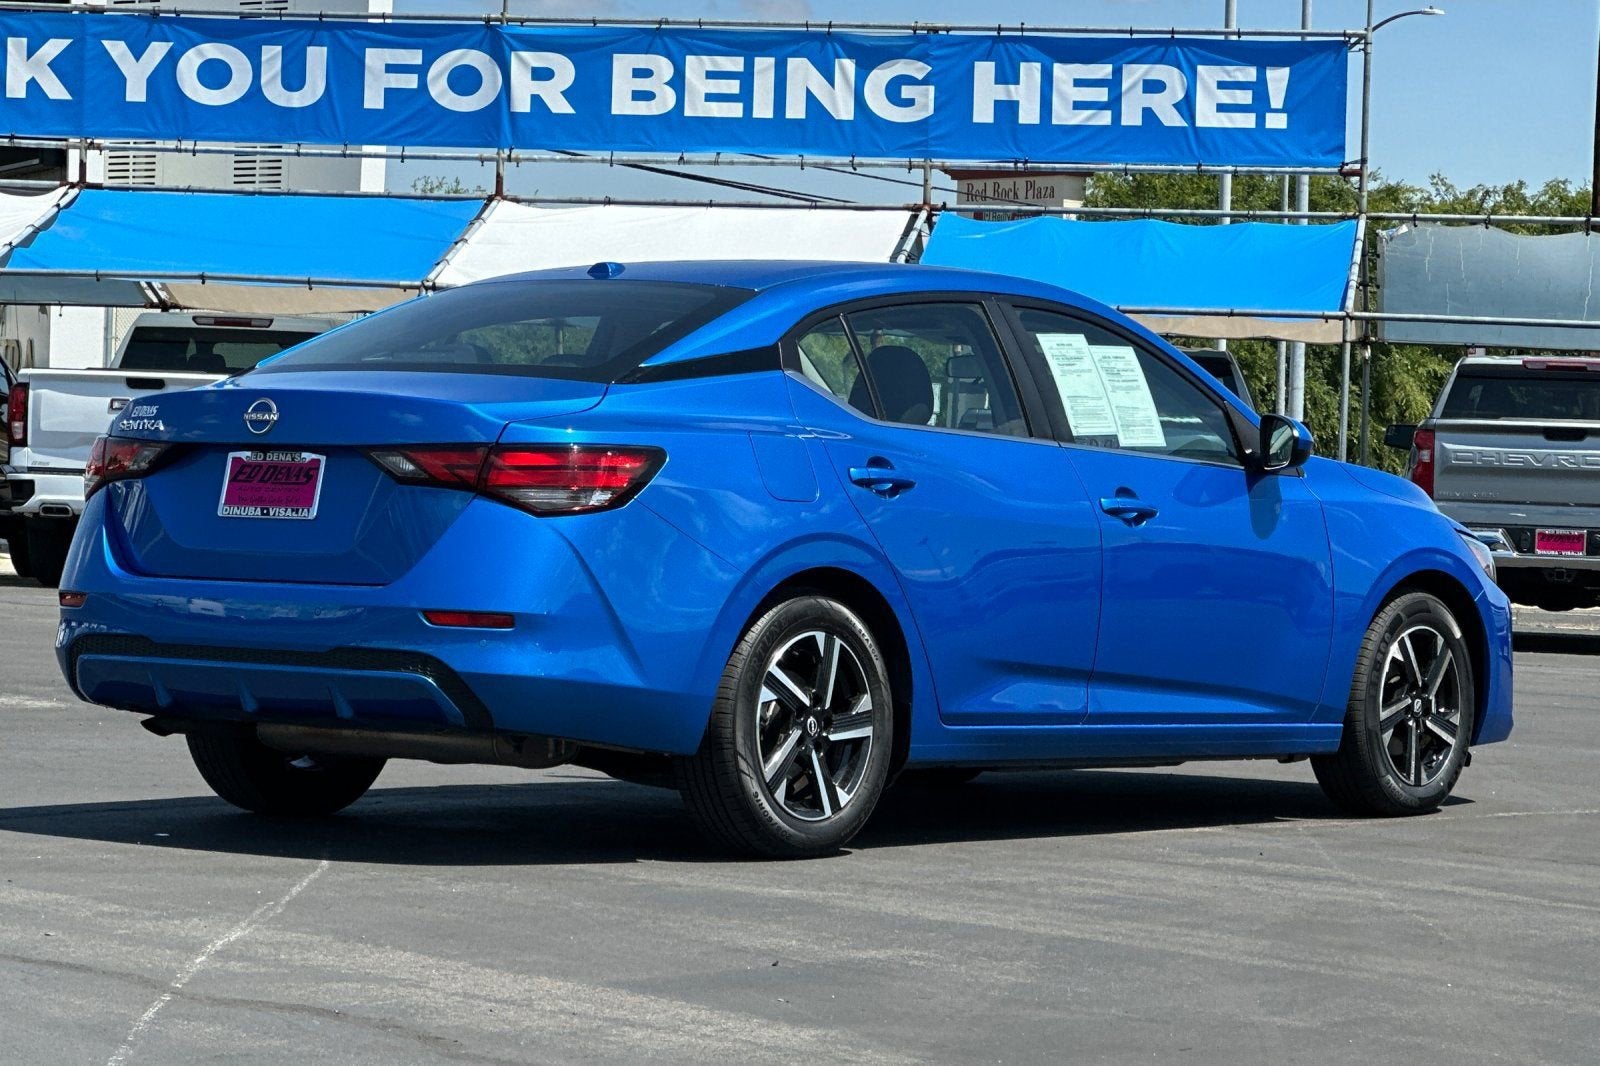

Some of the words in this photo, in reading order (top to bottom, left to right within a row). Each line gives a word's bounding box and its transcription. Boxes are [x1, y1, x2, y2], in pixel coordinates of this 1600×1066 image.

[5, 37, 74, 101] K
[101, 40, 329, 109] YOU
[363, 47, 577, 115] FOR
[610, 52, 936, 123] BEING
[972, 60, 1291, 130] HERE!
[966, 182, 987, 202] Red
[993, 180, 1020, 200] Rock
[1025, 179, 1055, 200] Plaza
[244, 413, 279, 422] NISSAN
[119, 419, 164, 431] SENTRA
[251, 453, 264, 461] ED
[266, 452, 301, 462] DENA'S
[223, 506, 261, 516] DINUBA
[269, 507, 309, 517] VISALIA
[857, 628, 879, 661] SEASON
